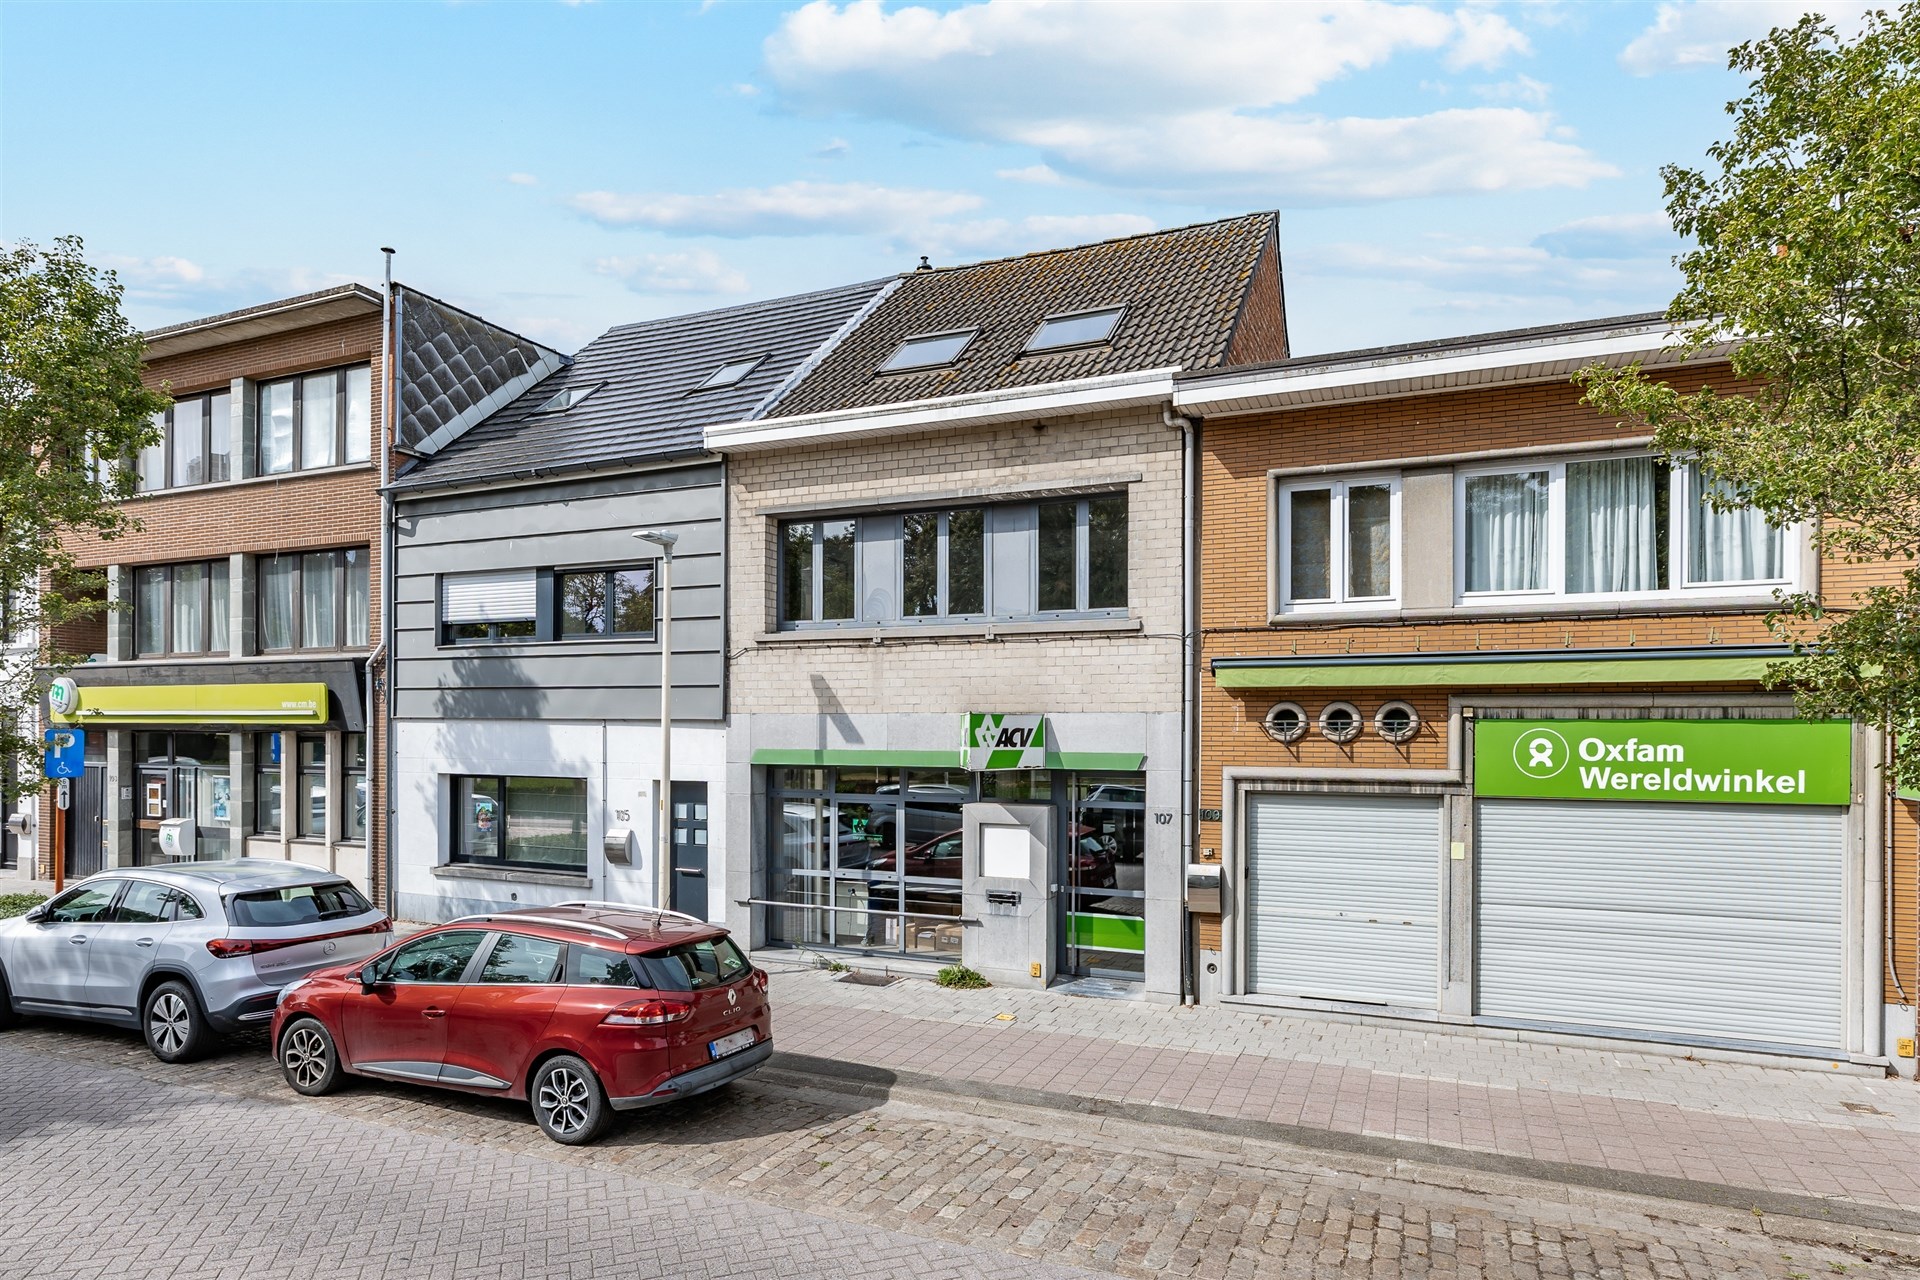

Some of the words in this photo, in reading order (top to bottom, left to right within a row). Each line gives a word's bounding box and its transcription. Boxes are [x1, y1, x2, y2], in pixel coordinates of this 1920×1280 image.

[281, 700, 317, 708] www.cm.be
[995, 727, 1034, 748] ACV
[1578, 737, 1684, 762] Oxfam
[1579, 766, 1806, 794] Wereldwinkel
[1154, 813, 1173, 825] 107
[1200, 809, 1221, 821] 109
[723, 1006, 741, 1016] CLIO
